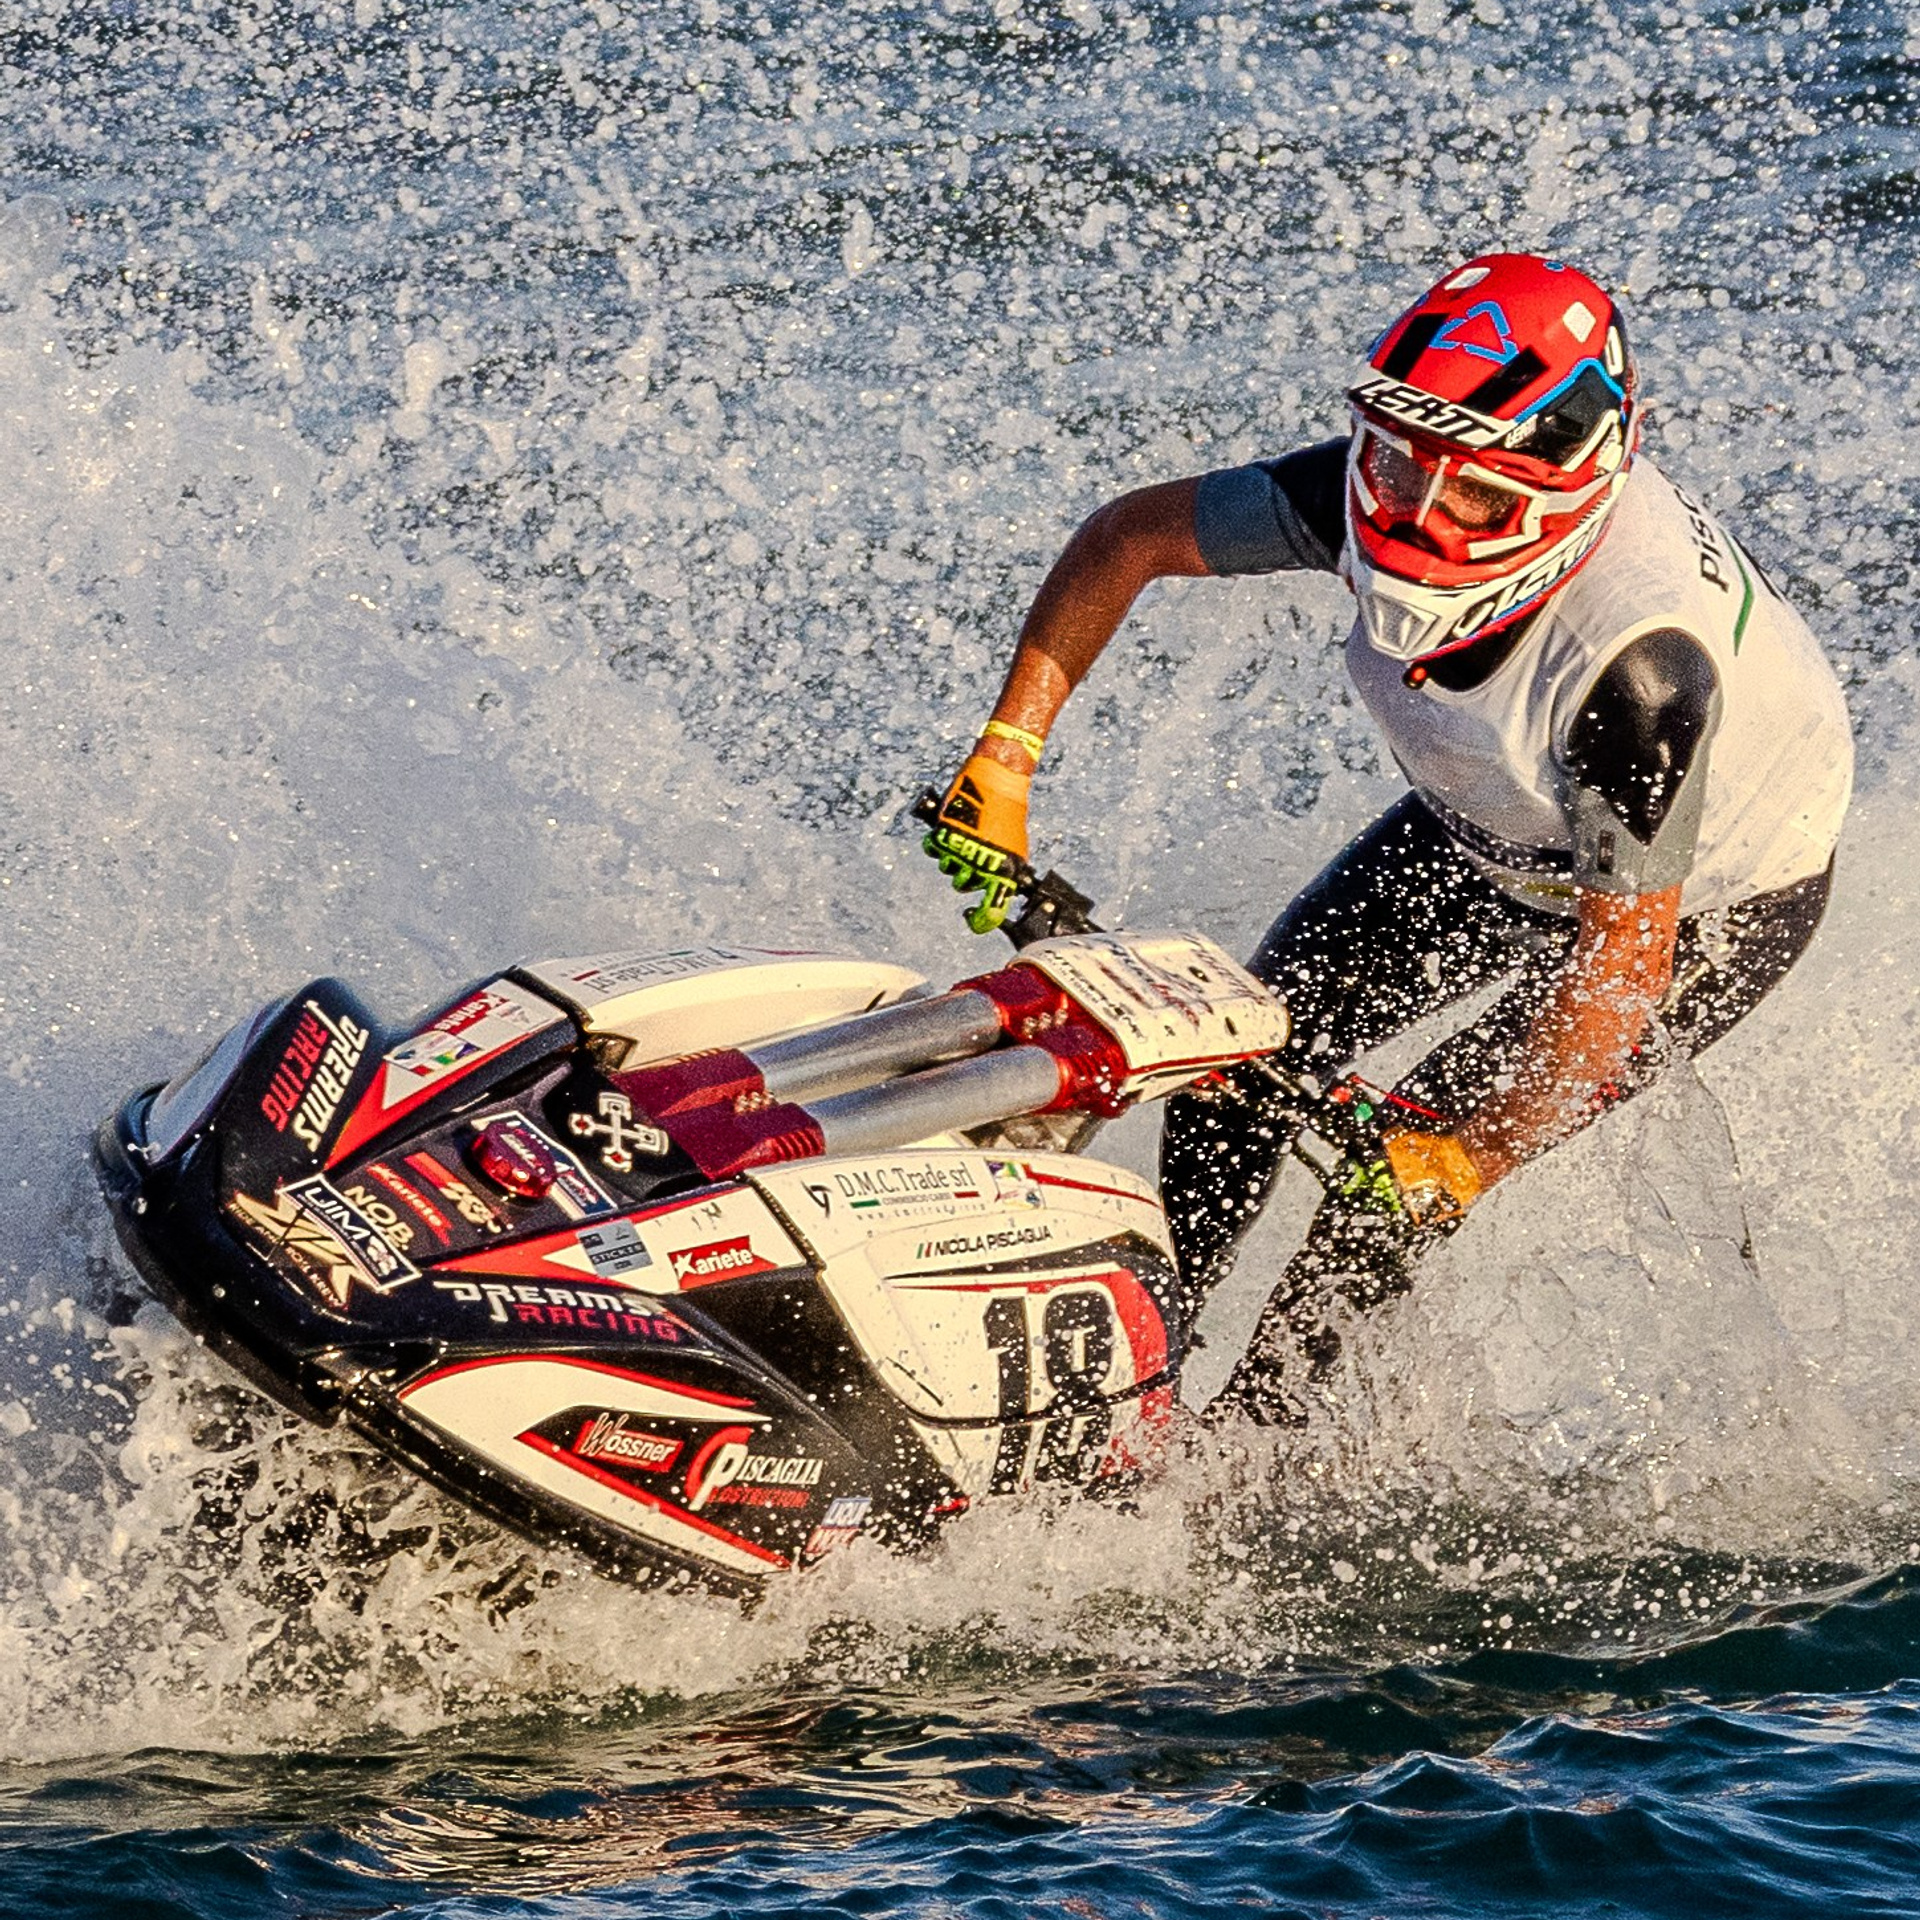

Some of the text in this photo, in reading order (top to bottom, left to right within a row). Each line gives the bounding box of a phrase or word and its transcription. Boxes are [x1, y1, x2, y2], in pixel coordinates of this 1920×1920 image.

[1350, 377, 1498, 438] LEATT
[937, 827, 1008, 872] LEATT
[261, 1012, 329, 1133] RACING
[291, 1000, 370, 1153] DREAMS
[950, 1161, 976, 1187] srl
[304, 1186, 371, 1241] UIM
[935, 1225, 1053, 1258] NICOLA PISCAGLIA
[433, 1279, 658, 1324] DREAMS
[512, 1303, 679, 1343] RACING
[688, 1442, 824, 1511] PISCAGLIA
